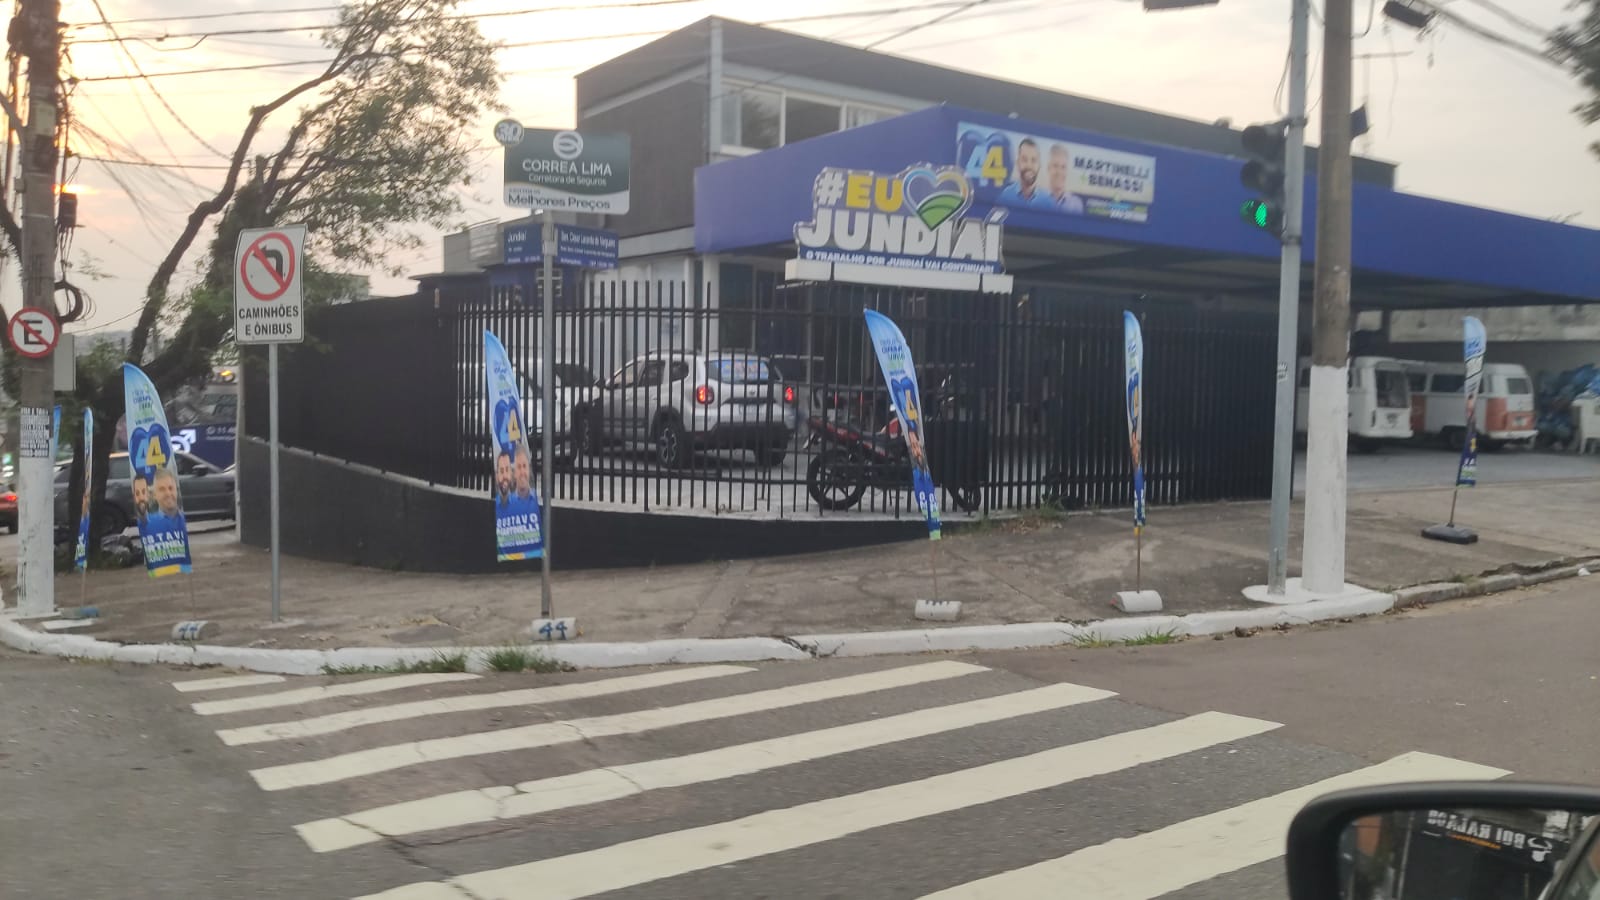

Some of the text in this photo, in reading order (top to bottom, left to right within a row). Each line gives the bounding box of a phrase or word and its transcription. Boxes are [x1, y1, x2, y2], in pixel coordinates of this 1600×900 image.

[522, 159, 613, 176] CORREA LIMA
[966, 144, 1008, 187] 44
[528, 173, 607, 187] Corretora de Seguros
[816, 171, 904, 212] #EU
[508, 193, 610, 210] Melhores Preços
[799, 208, 1007, 261] JUNDIAÍ
[806, 252, 814, 260] O
[815, 252, 866, 265] TRABALHO
[866, 256, 885, 266] POR
[886, 256, 924, 269] JUNDIAÍ
[925, 260, 940, 271] VAI
[238, 304, 299, 319] CAMINHÕES
[24, 319, 43, 345] E
[245, 323, 293, 336] E ÔNIBUS
[135, 435, 167, 474] 44
[496, 513, 538, 528] GUSTAVO
[538, 621, 568, 641] 44
